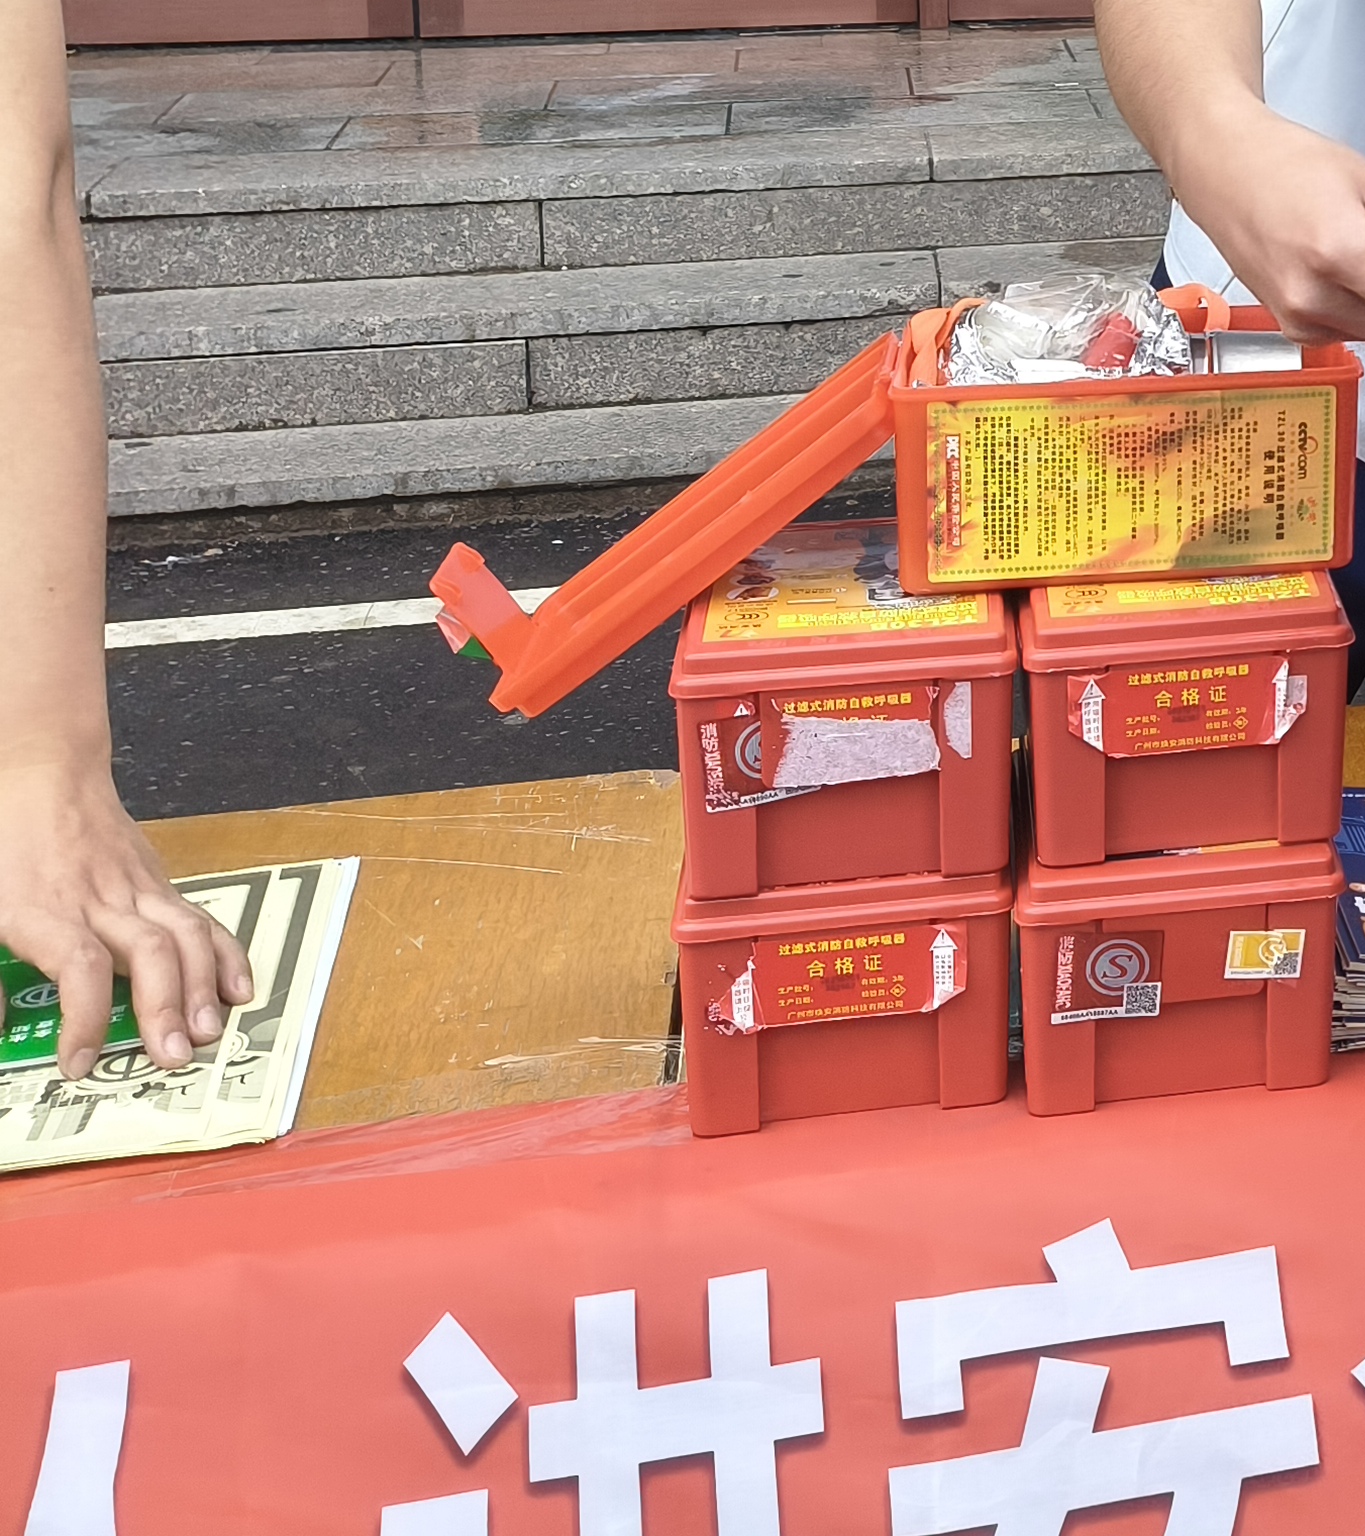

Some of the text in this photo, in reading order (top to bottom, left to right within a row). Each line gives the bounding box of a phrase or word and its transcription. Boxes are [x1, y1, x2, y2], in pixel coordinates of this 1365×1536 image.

[783, 692, 912, 715] 过滤式消防自救呼吸器
[1154, 685, 1228, 709] 合格证
[778, 932, 906, 957] 过滤式消防自救呼吸器
[806, 953, 884, 979] 合格证
